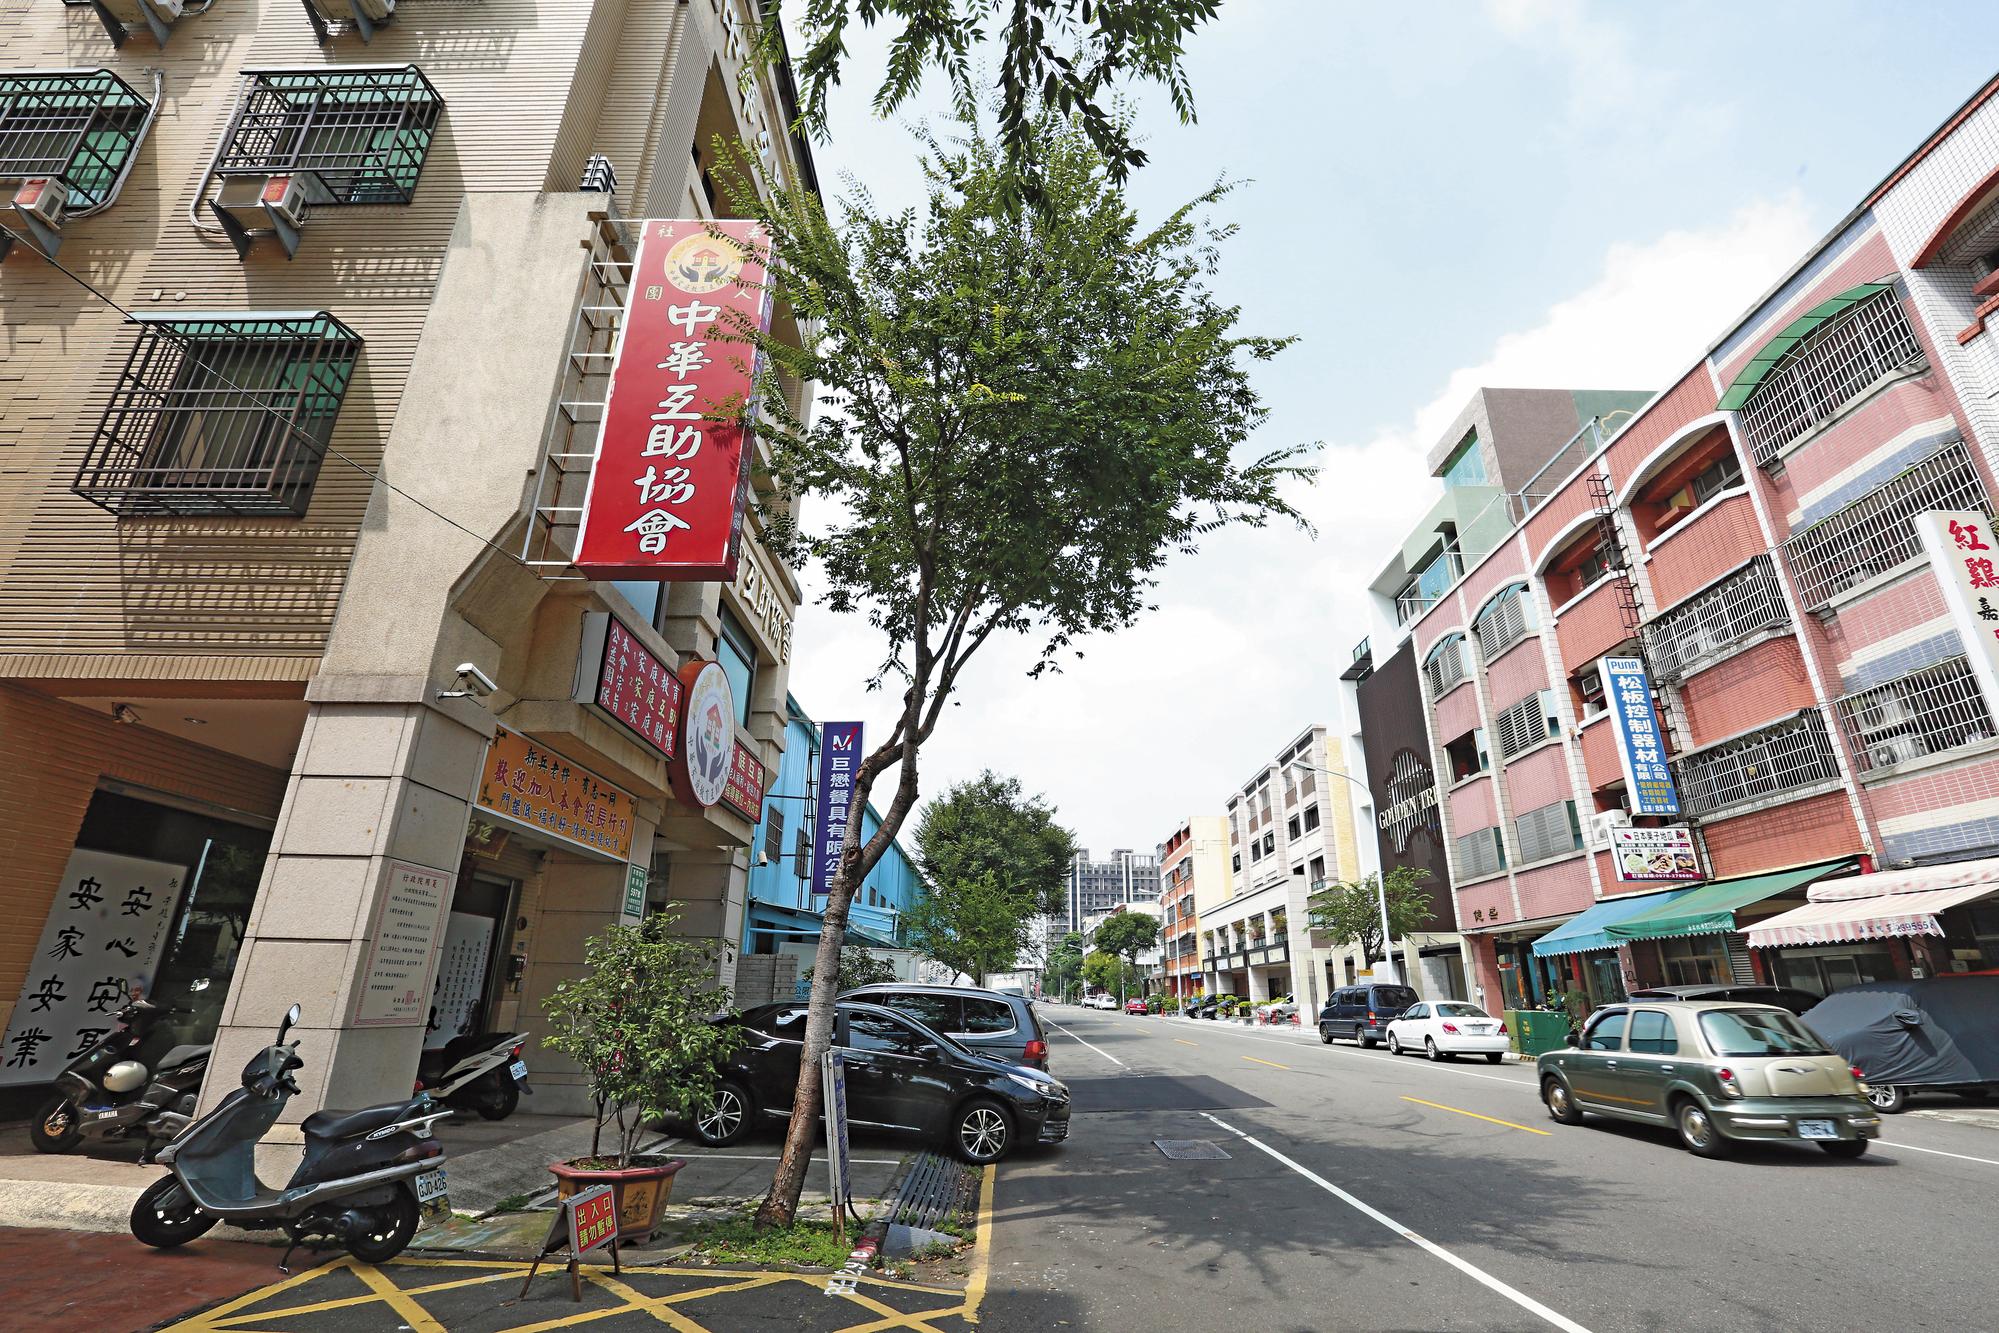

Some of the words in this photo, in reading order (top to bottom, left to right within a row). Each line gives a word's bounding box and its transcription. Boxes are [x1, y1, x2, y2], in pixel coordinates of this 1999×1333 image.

[623, 300, 722, 555] 中華互助協會
[612, 635, 630, 712] 本會宗旨
[1617, 675, 1658, 763] 松板控制器材
[494, 759, 628, 837] 歡迎加入本會組長行列
[1379, 796, 1418, 829] GOLDEN
[577, 1196, 610, 1226] 出入口
[579, 1215, 613, 1248] 請勿暫停
